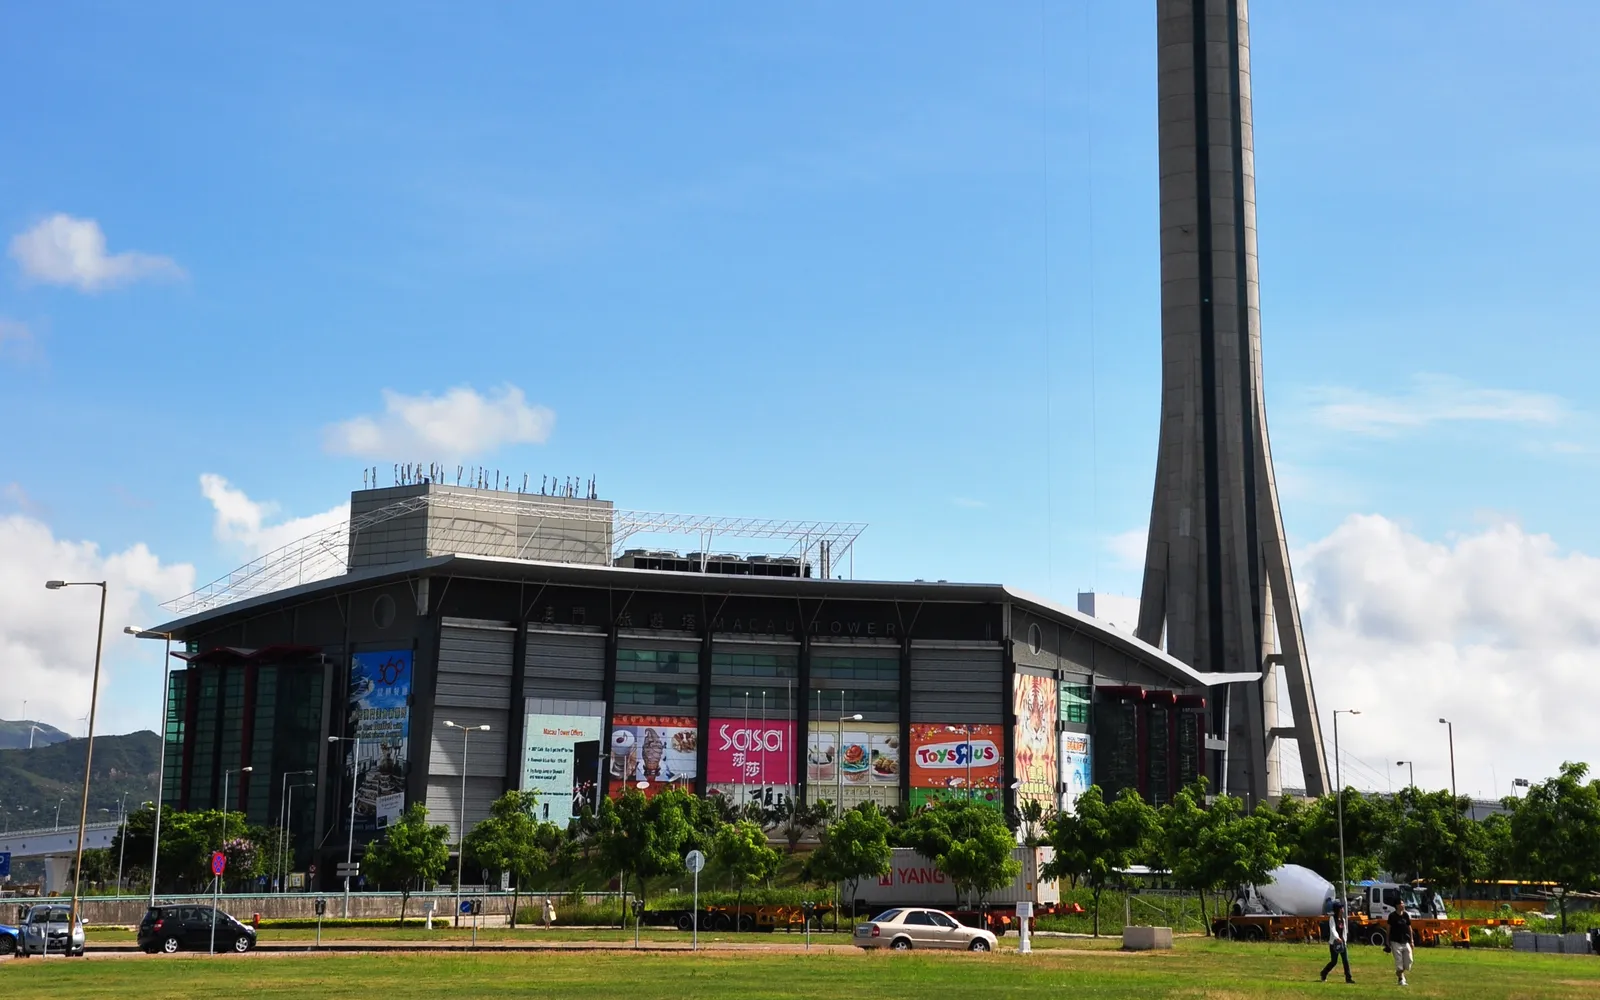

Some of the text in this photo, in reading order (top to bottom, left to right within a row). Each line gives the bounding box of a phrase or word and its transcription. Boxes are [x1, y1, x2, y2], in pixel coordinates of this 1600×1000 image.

[712, 616, 896, 634] MACAU TOWER
[543, 728, 557, 736] Macau
[557, 728, 570, 737] Tower
[897, 867, 945, 884] YANG
